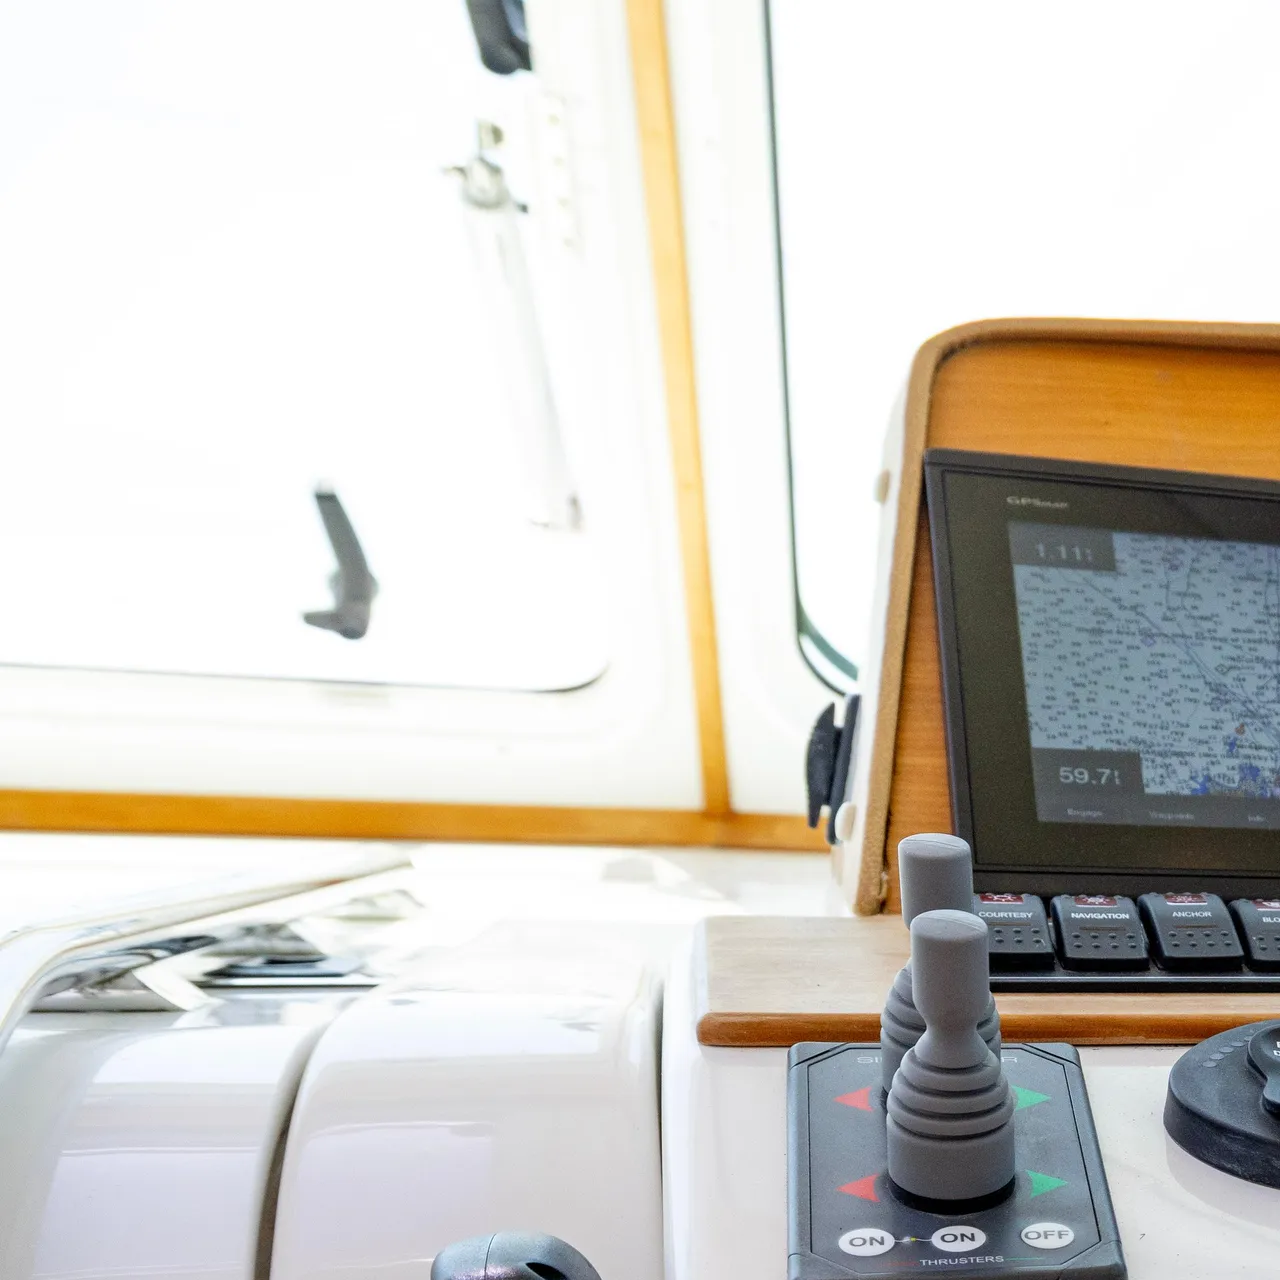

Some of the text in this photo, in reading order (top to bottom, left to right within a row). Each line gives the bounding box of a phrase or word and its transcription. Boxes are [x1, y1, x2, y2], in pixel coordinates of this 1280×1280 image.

[978, 911, 1033, 919] COURTESY
[1071, 912, 1130, 920] NAVIGATION
[940, 1233, 976, 1243] ON
[1024, 1230, 1070, 1241] OFF
[849, 1236, 885, 1247] ON
[919, 1255, 1004, 1266] THRUSTERS
